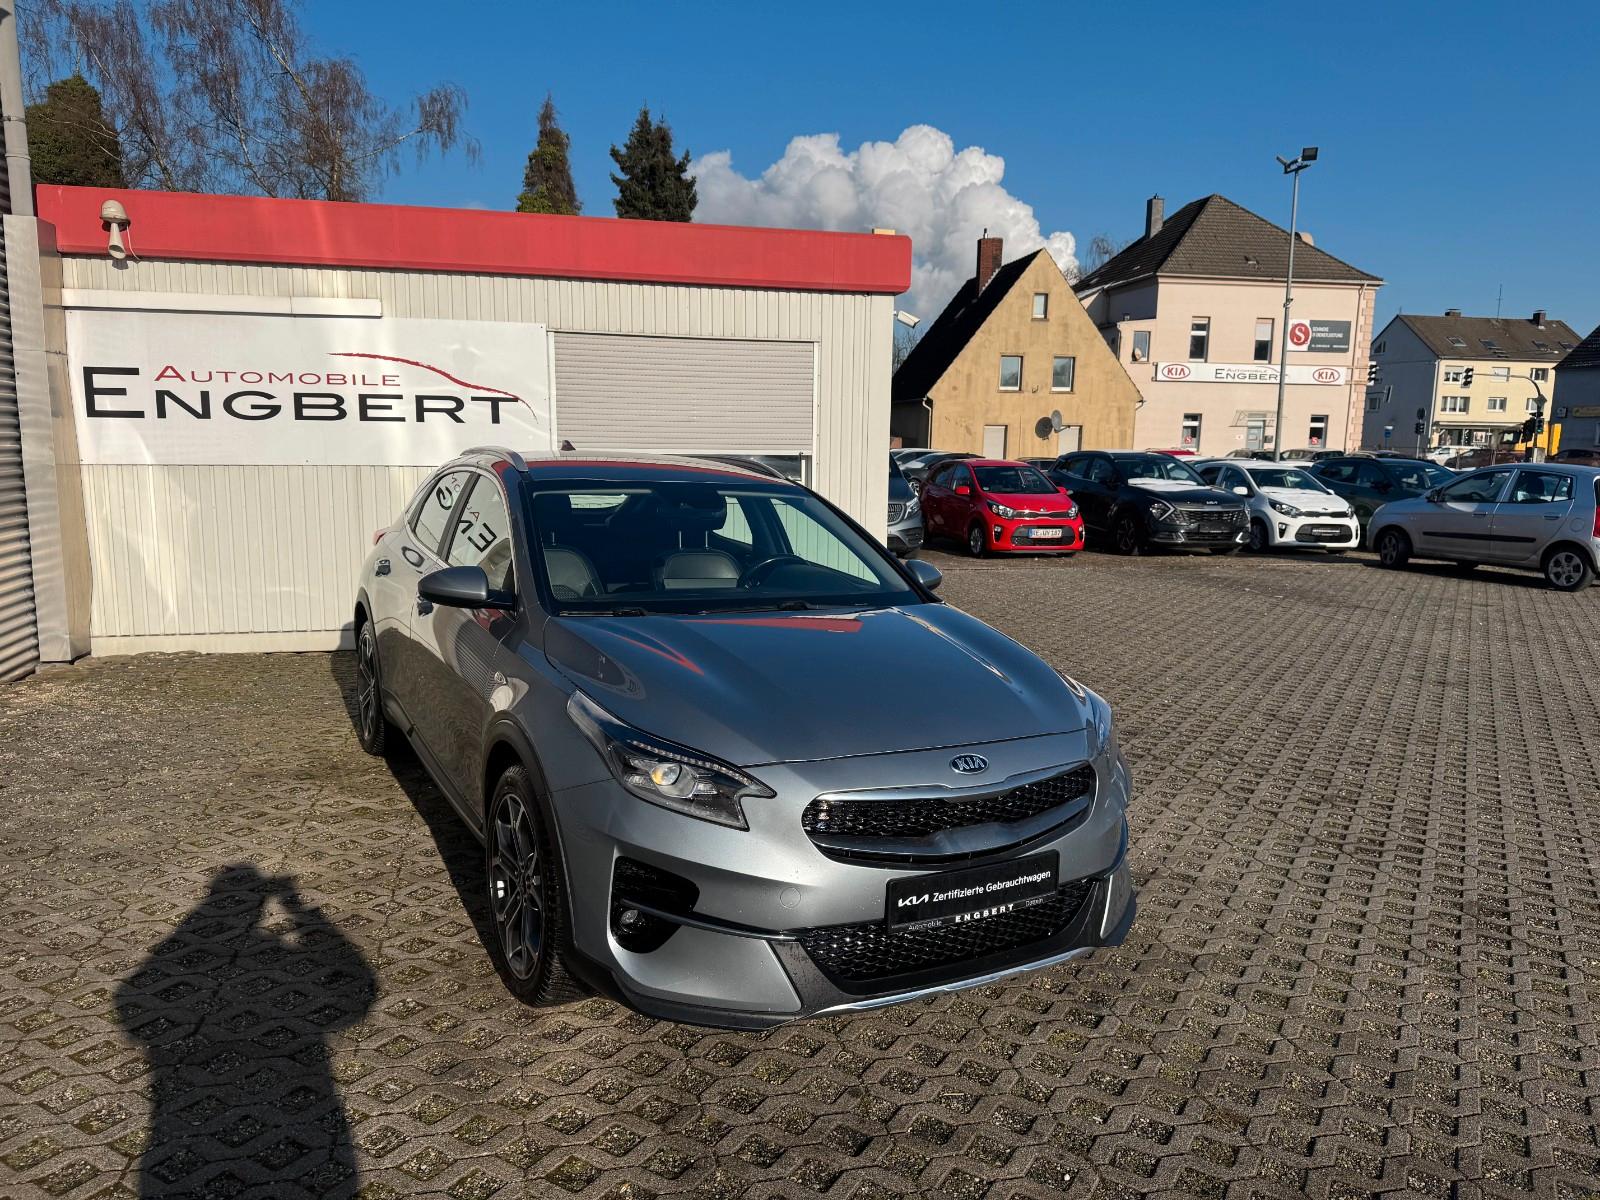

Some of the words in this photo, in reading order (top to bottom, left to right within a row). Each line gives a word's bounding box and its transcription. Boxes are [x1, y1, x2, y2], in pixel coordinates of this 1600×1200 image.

[154, 365, 401, 386] AUTOMOBILE
[1167, 367, 1186, 376] KIA
[1214, 368, 1289, 381] ENGBER
[1317, 371, 1336, 380] KIA
[82, 365, 519, 425] ENGBERT
[954, 756, 985, 770] KIA
[898, 894, 929, 907] KIA
[933, 885, 984, 902] Zertifizierte
[986, 870, 1051, 892] Gebrauchtwagen
[955, 903, 1014, 923] ENGBERT
